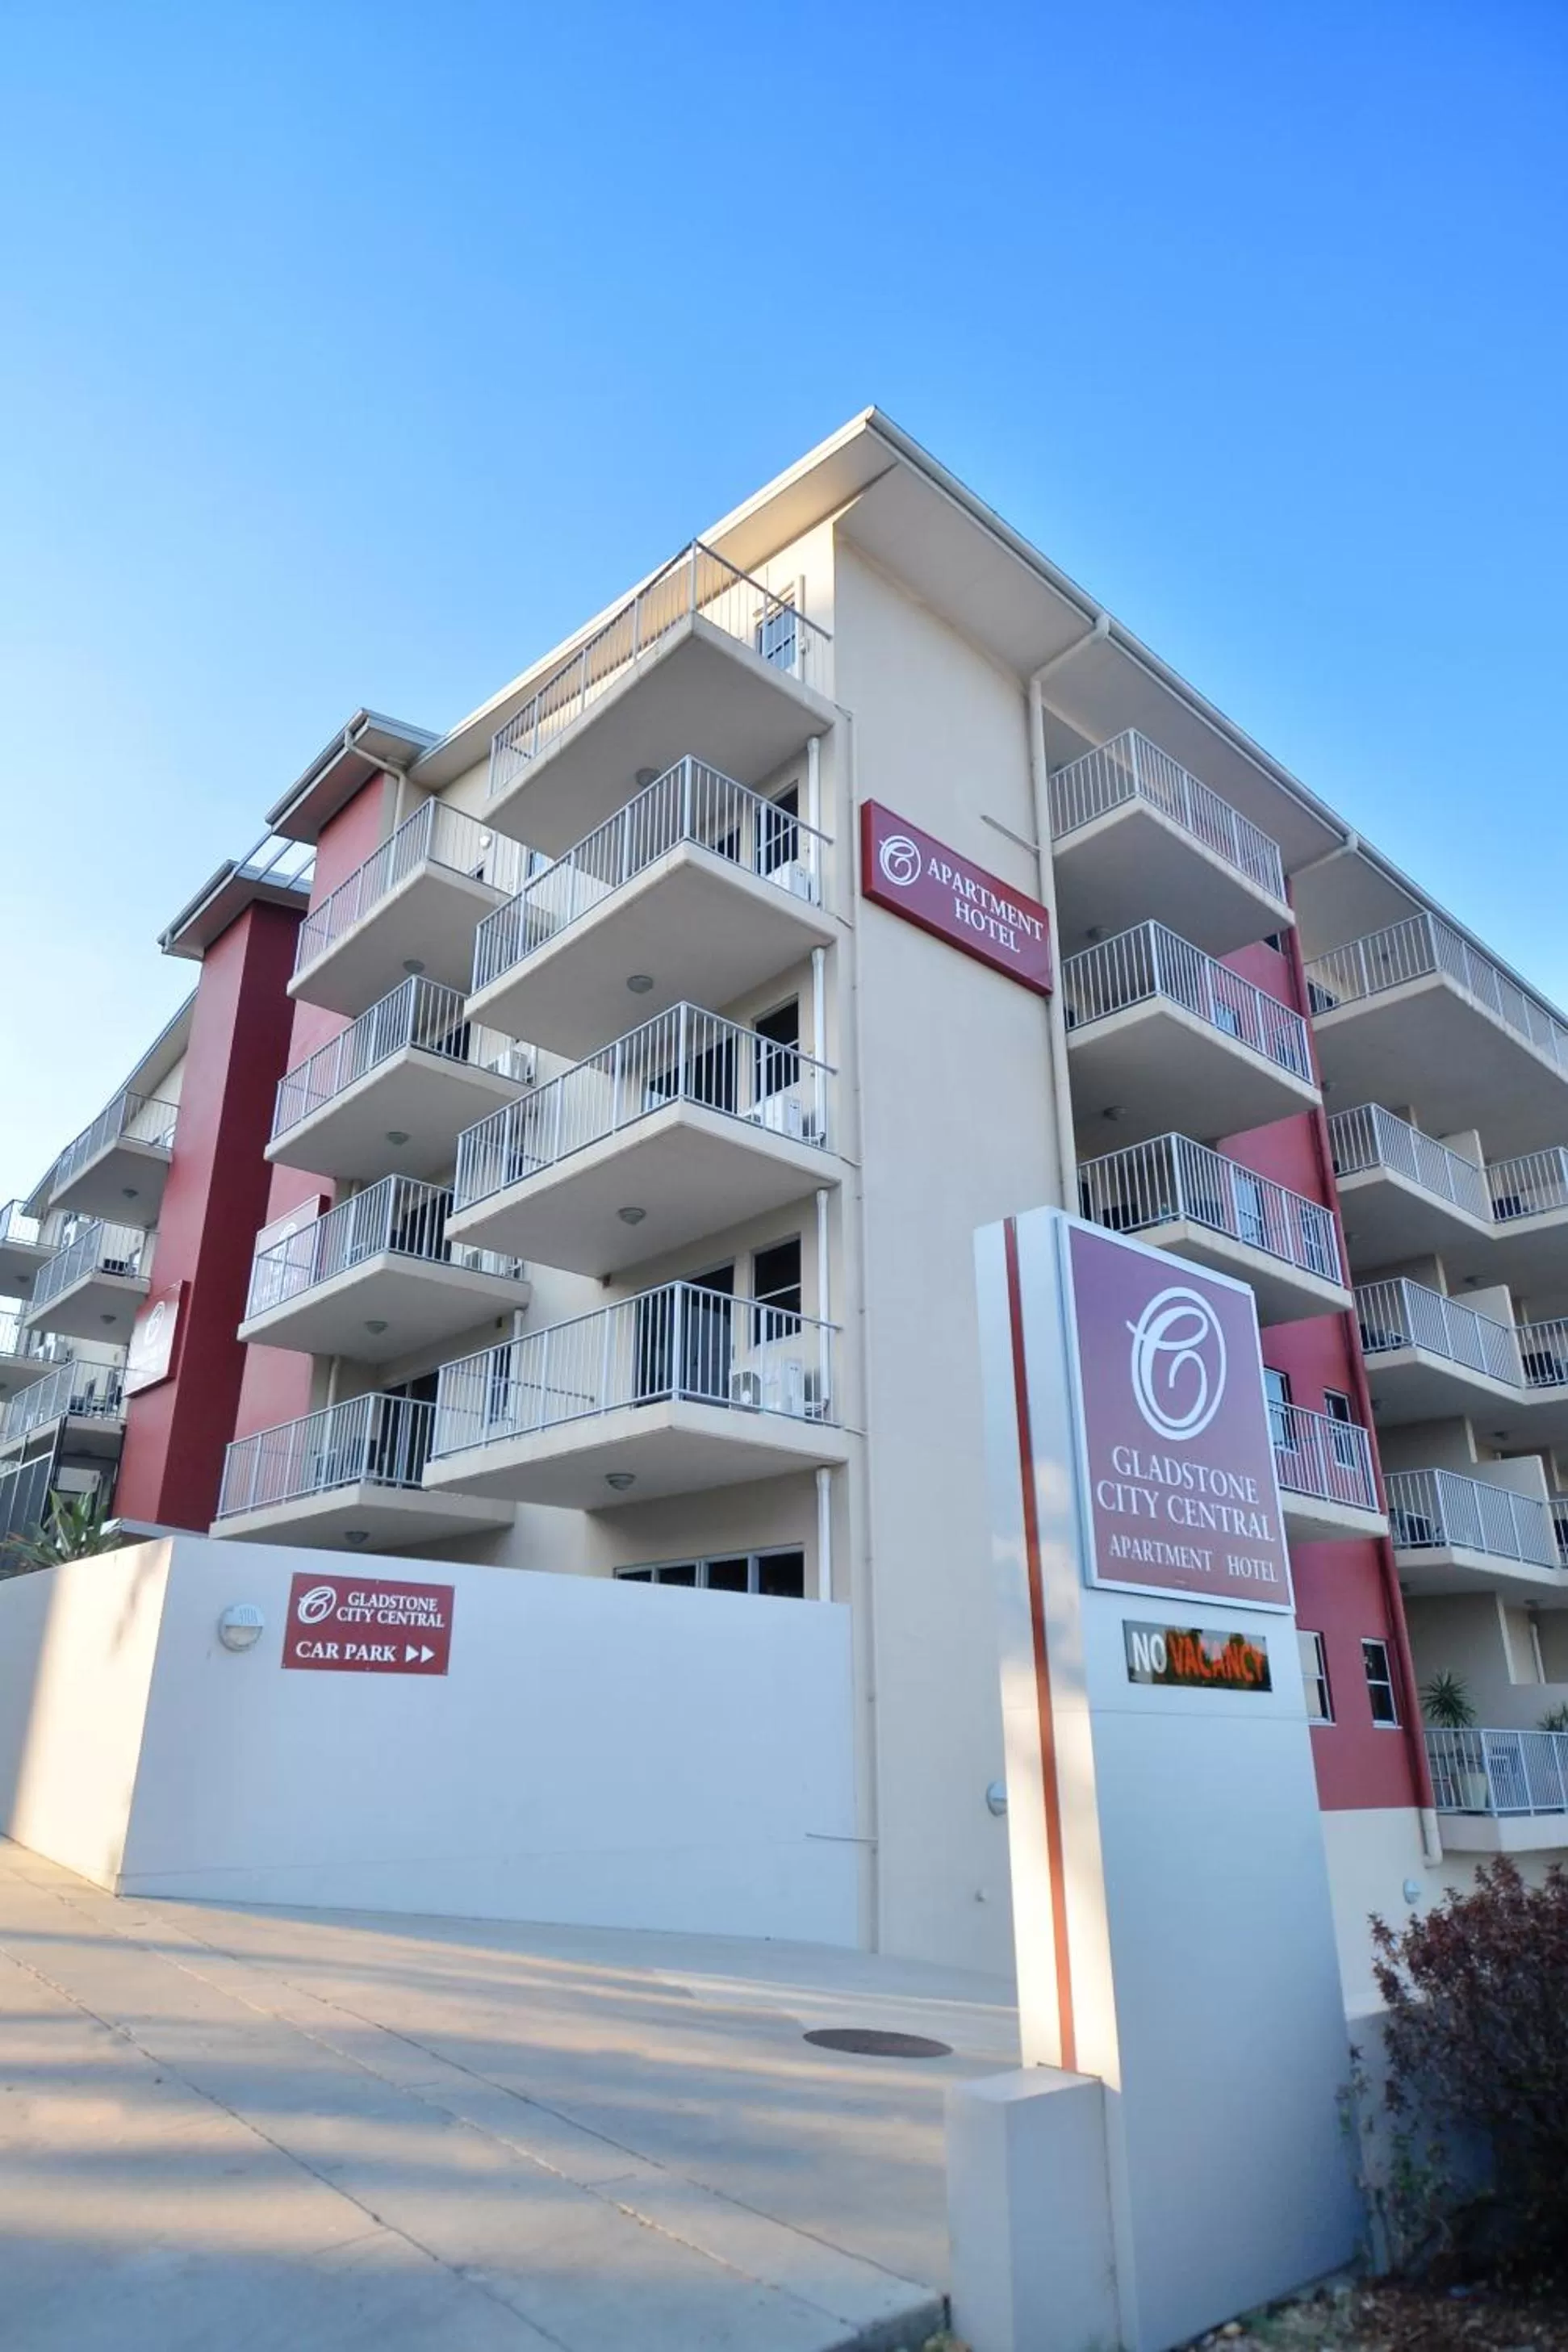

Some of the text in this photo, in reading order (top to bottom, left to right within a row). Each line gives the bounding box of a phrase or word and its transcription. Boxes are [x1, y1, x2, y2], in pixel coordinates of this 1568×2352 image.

[927, 858, 1042, 940] APARTMENT
[955, 897, 1019, 952] HOTEL
[1112, 1445, 1258, 1503] GLADSTONE
[1097, 1479, 1274, 1541] CITY CENTRAL
[1109, 1534, 1277, 1581] APARTMENT HOTEL
[336, 1607, 443, 1626] CITY CENTRAL
[347, 1592, 437, 1611] GLADSTONE
[295, 1641, 396, 1661] CAR PARK
[1131, 1630, 1265, 1680] NO VACANCY
